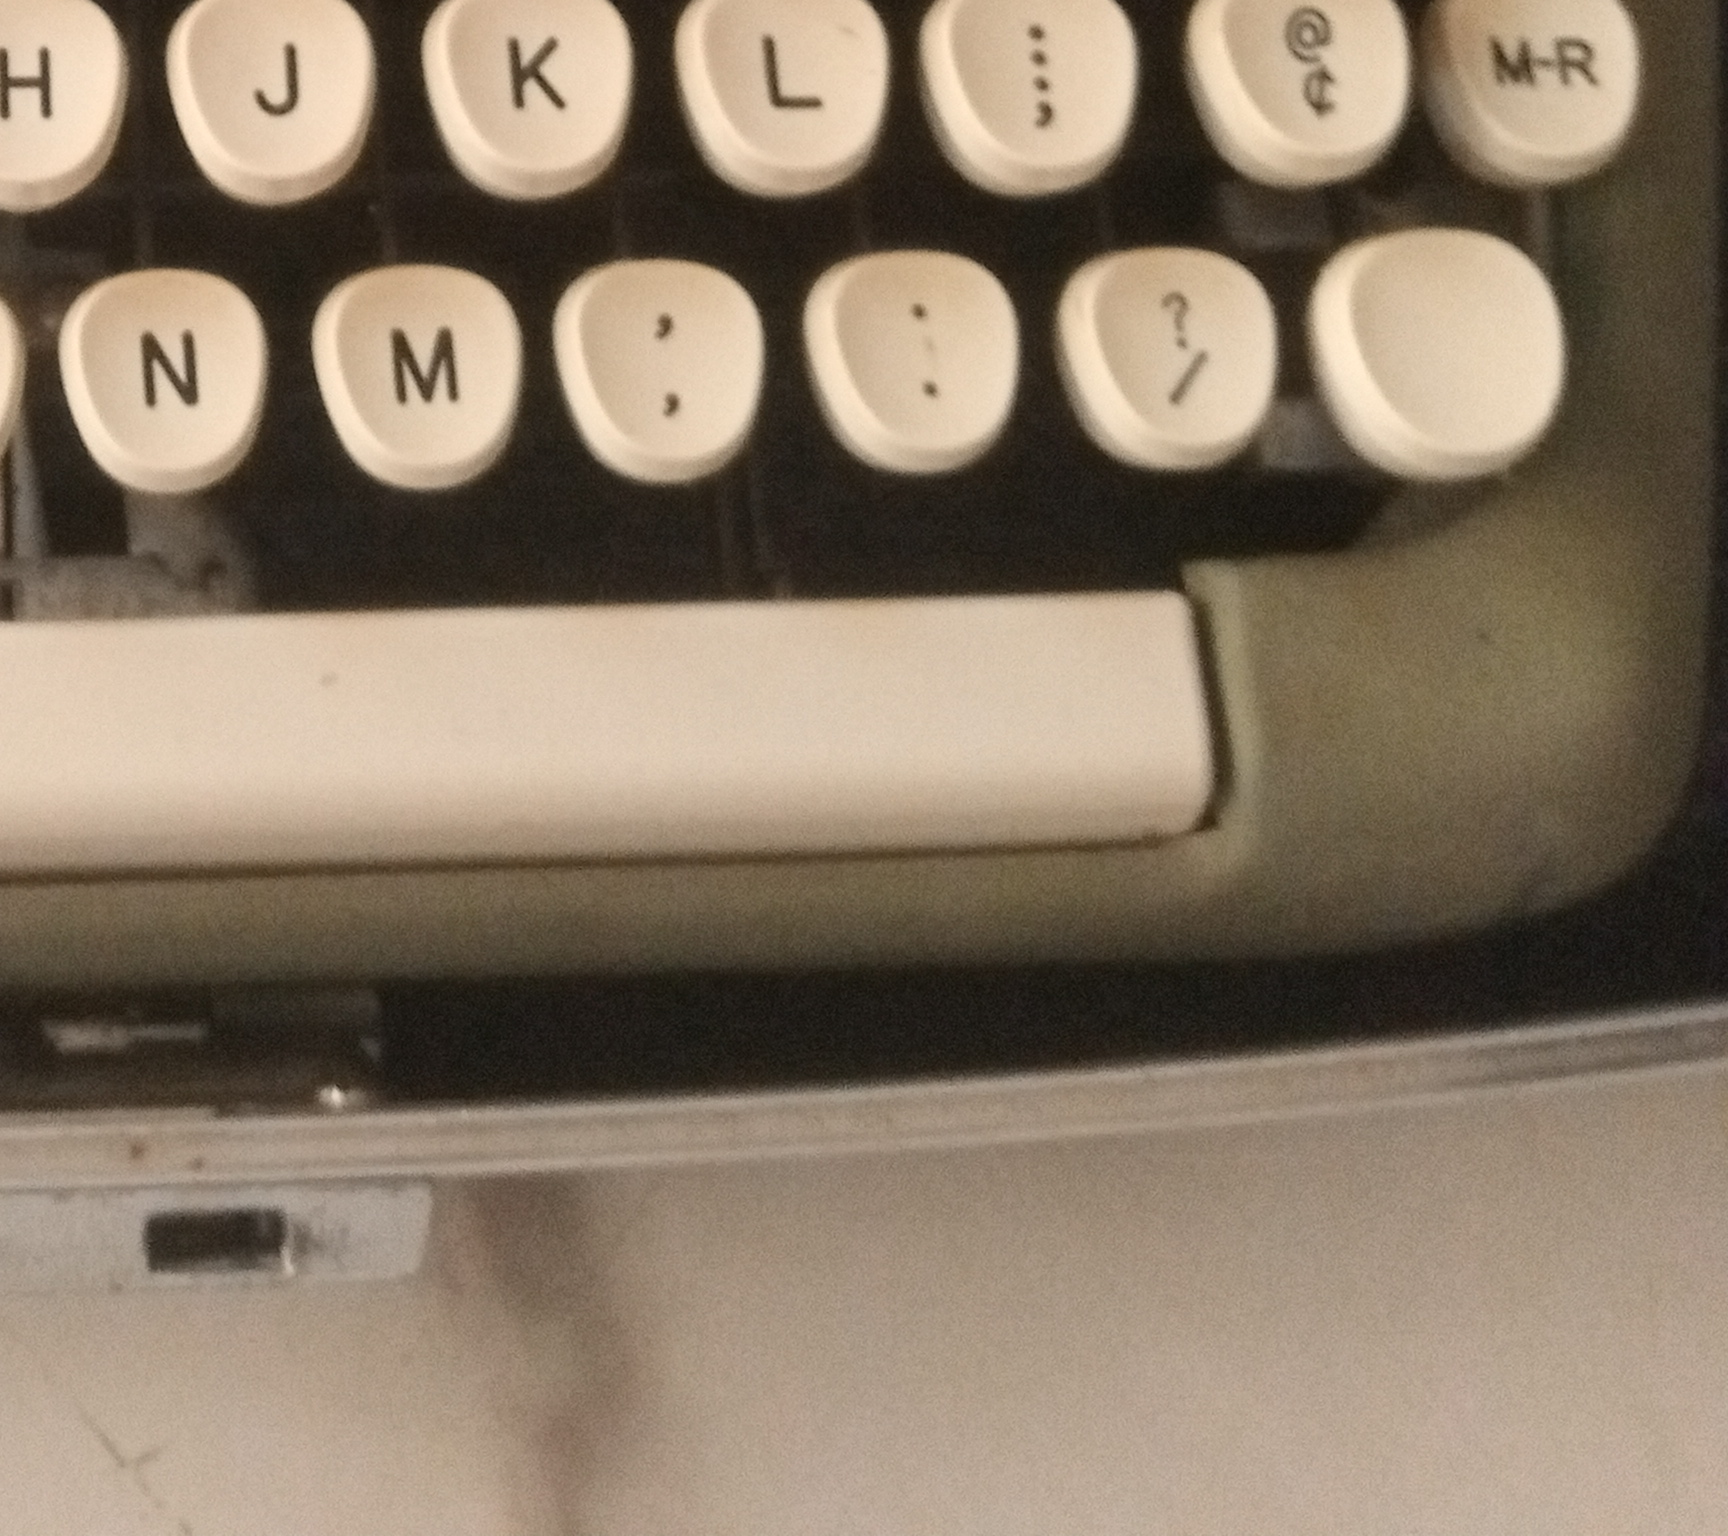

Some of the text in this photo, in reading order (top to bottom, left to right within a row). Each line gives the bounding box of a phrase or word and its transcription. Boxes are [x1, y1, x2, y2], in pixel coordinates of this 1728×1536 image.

[760, 34, 824, 111] L
[1285, 5, 1334, 63] @
[1489, 37, 1599, 87] M-R
[253, 41, 301, 119] J
[506, 35, 568, 112] K
[1161, 291, 1190, 350] ?
[139, 328, 201, 410] N
[389, 326, 461, 406] M
